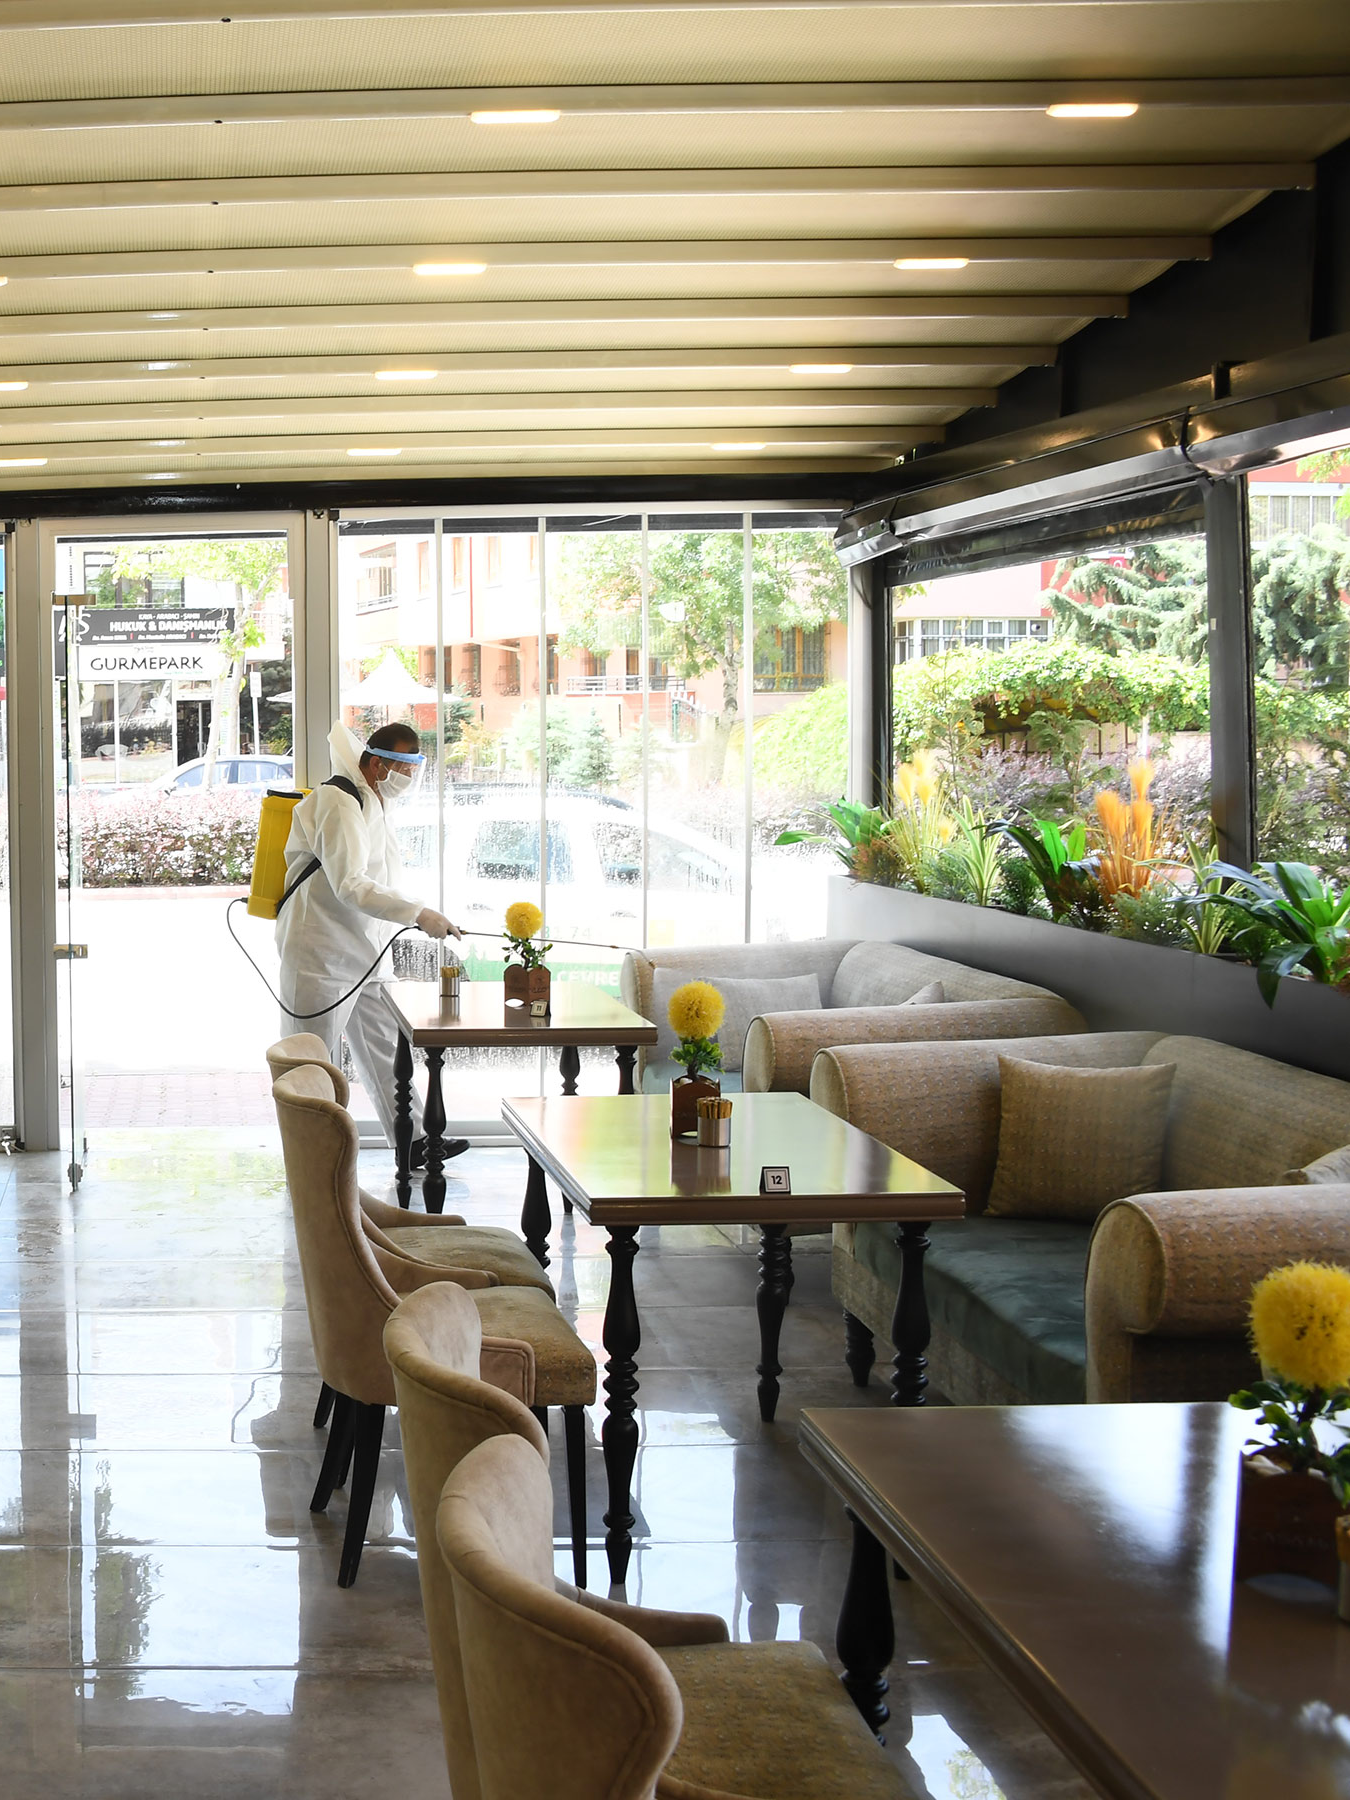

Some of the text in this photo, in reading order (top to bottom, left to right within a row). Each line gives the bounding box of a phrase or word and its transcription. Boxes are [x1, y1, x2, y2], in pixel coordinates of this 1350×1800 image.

[109, 619, 227, 633] HUKUK & DANIŞMANLIK
[90, 656, 204, 671] GURMEPARK
[770, 1175, 783, 1185] 12
